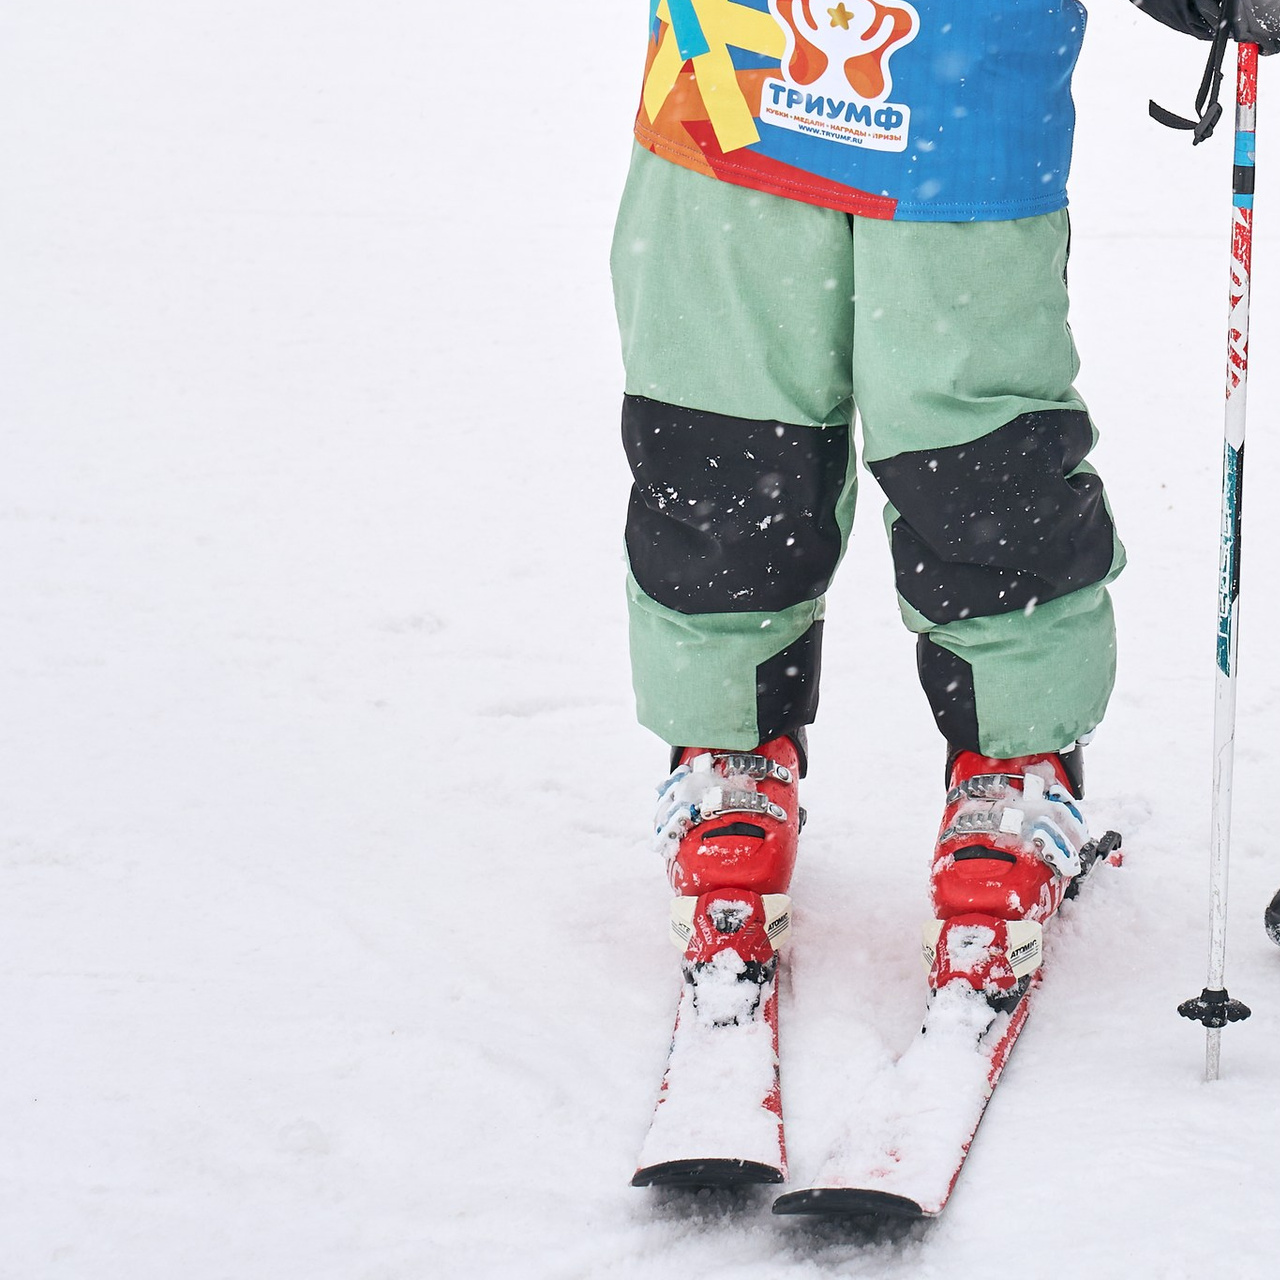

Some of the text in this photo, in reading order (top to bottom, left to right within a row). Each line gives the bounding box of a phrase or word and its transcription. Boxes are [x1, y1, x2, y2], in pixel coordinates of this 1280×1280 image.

[769, 83, 903, 131] ТРИУМФ
[766, 107, 788, 118] КУБКИ
[794, 115, 825, 128] МЕДАЛИ
[830, 124, 866, 137] НАГРАДЫ
[798, 124, 863, 144] WWW.TRYUMF.RU
[697, 915, 713, 945] ATOMIC
[768, 912, 788, 932] ATOMIC
[1010, 940, 1037, 959] ATOMIC
